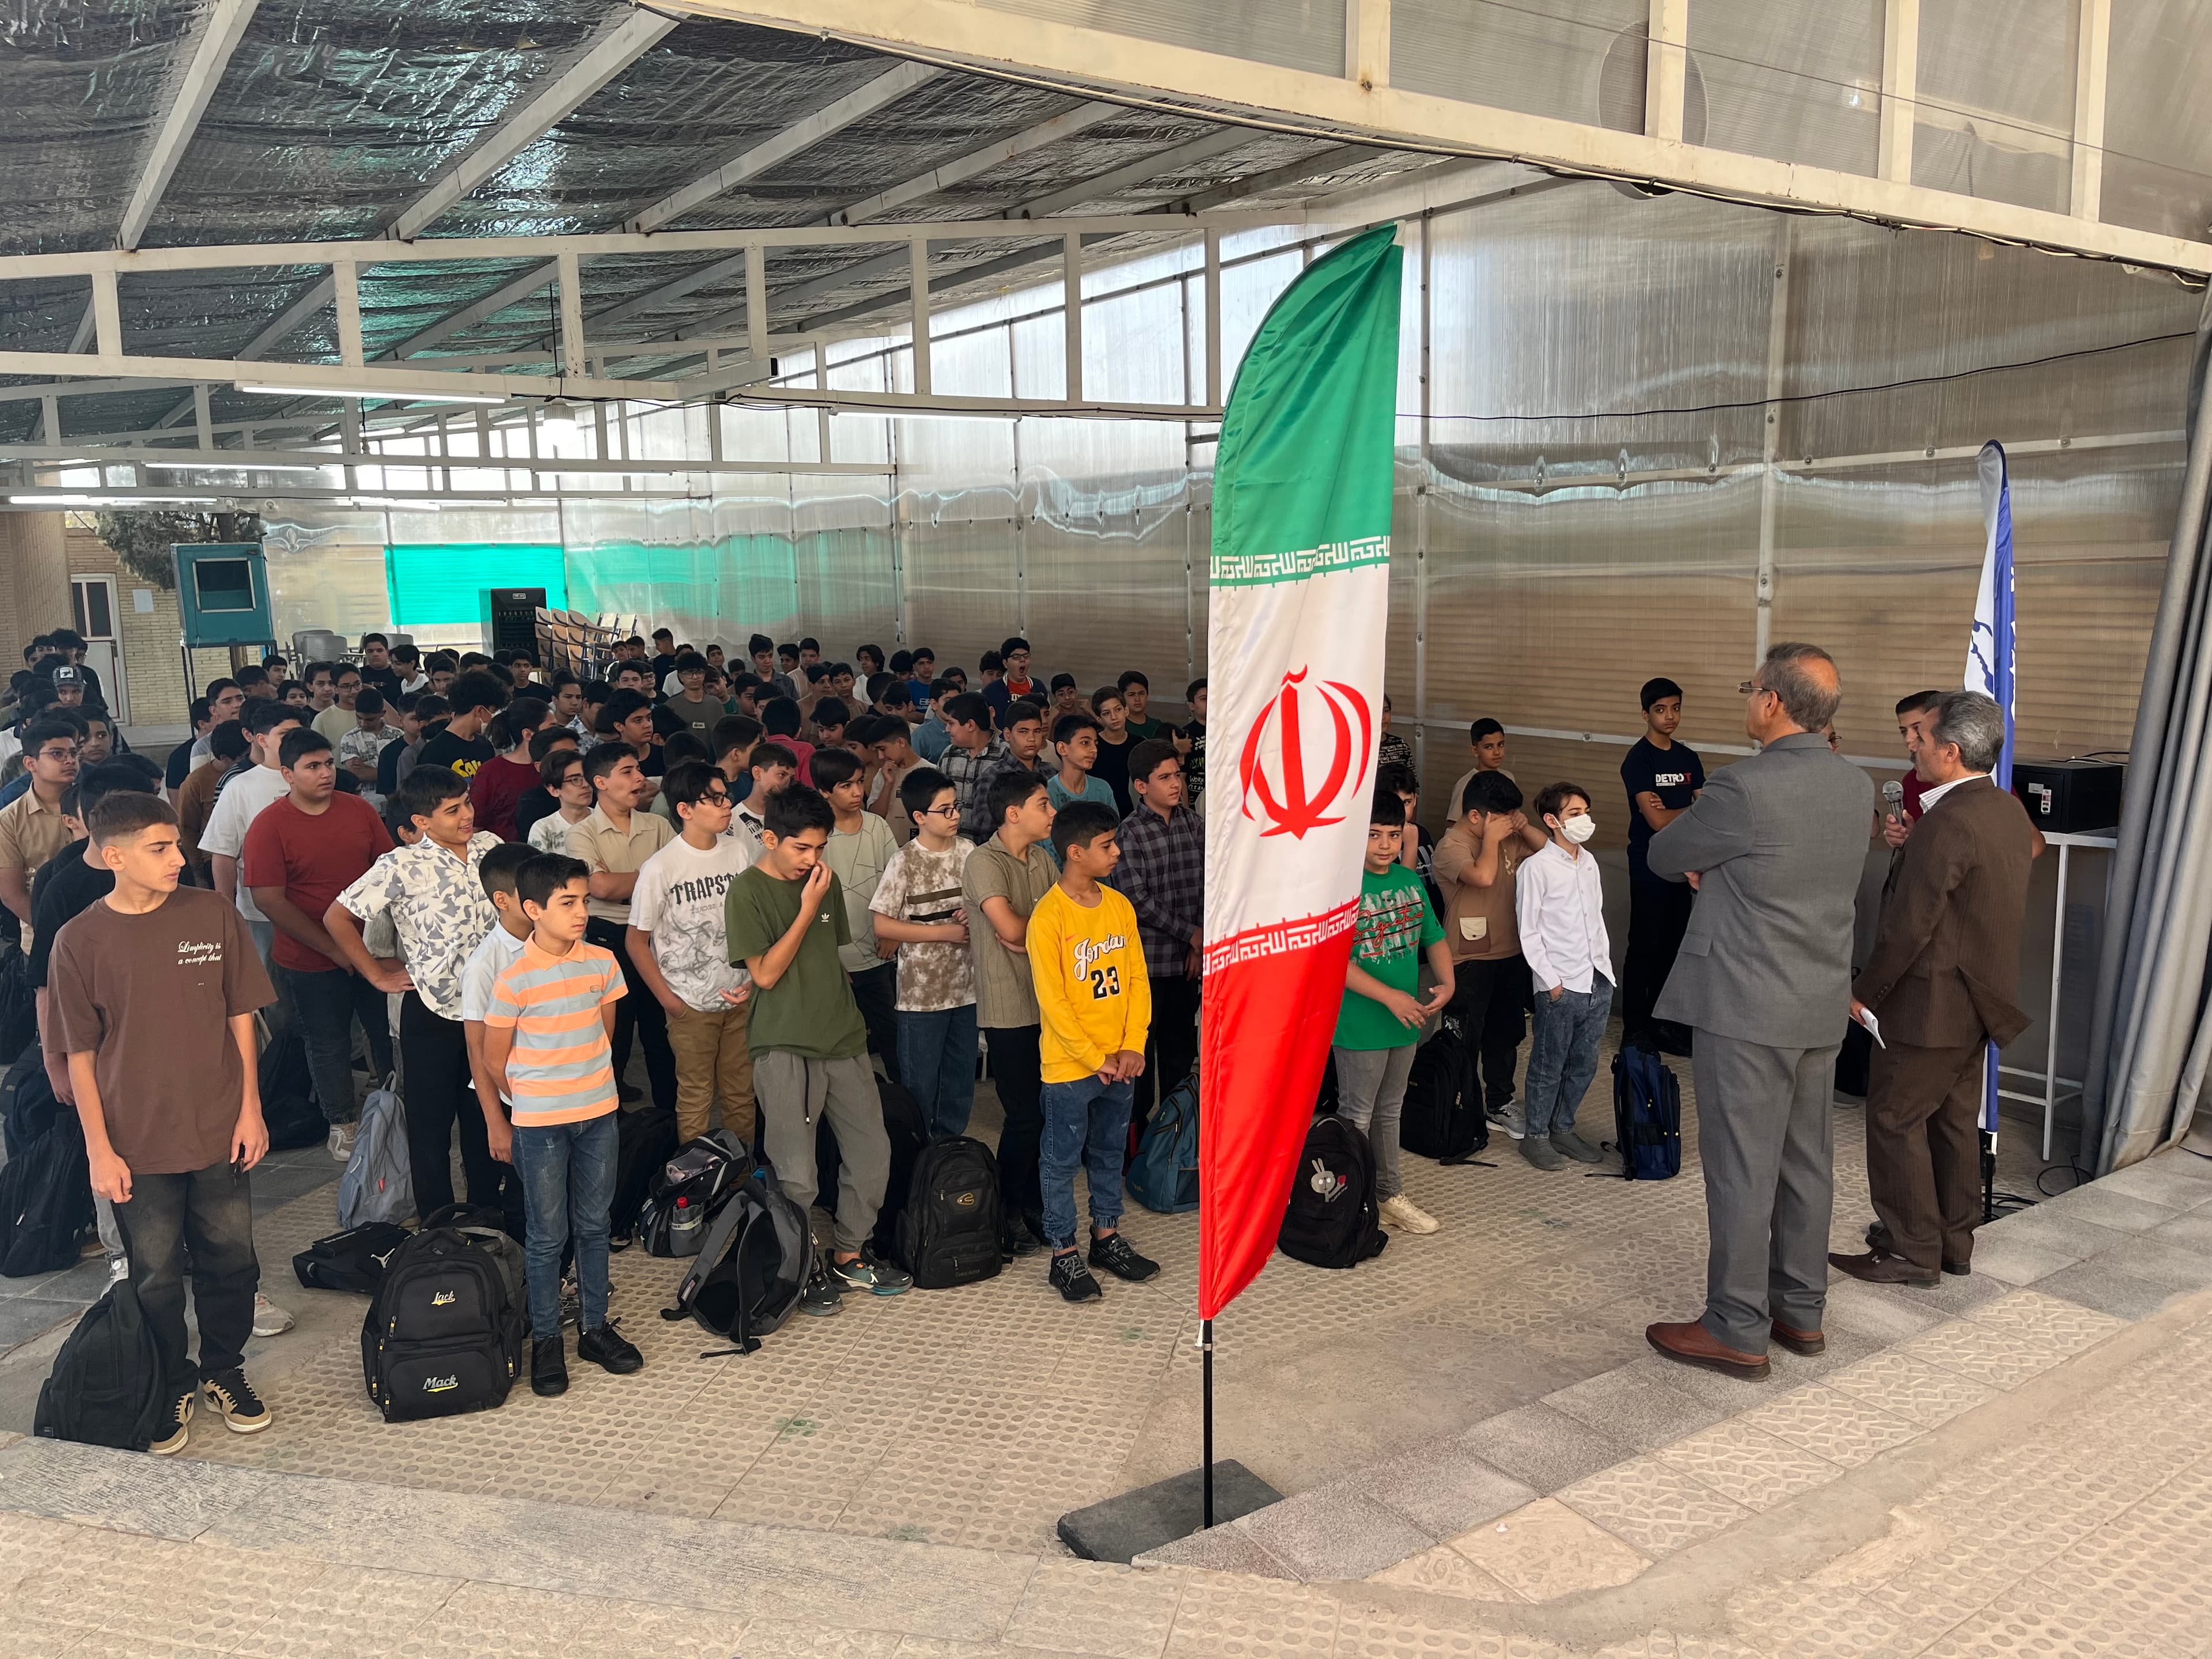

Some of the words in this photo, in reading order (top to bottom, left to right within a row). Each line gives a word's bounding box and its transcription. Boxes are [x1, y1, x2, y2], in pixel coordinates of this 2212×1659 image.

[208, 952, 222, 961] that
[1090, 965, 1120, 999] 23
[422, 1374, 457, 1391] Mack
